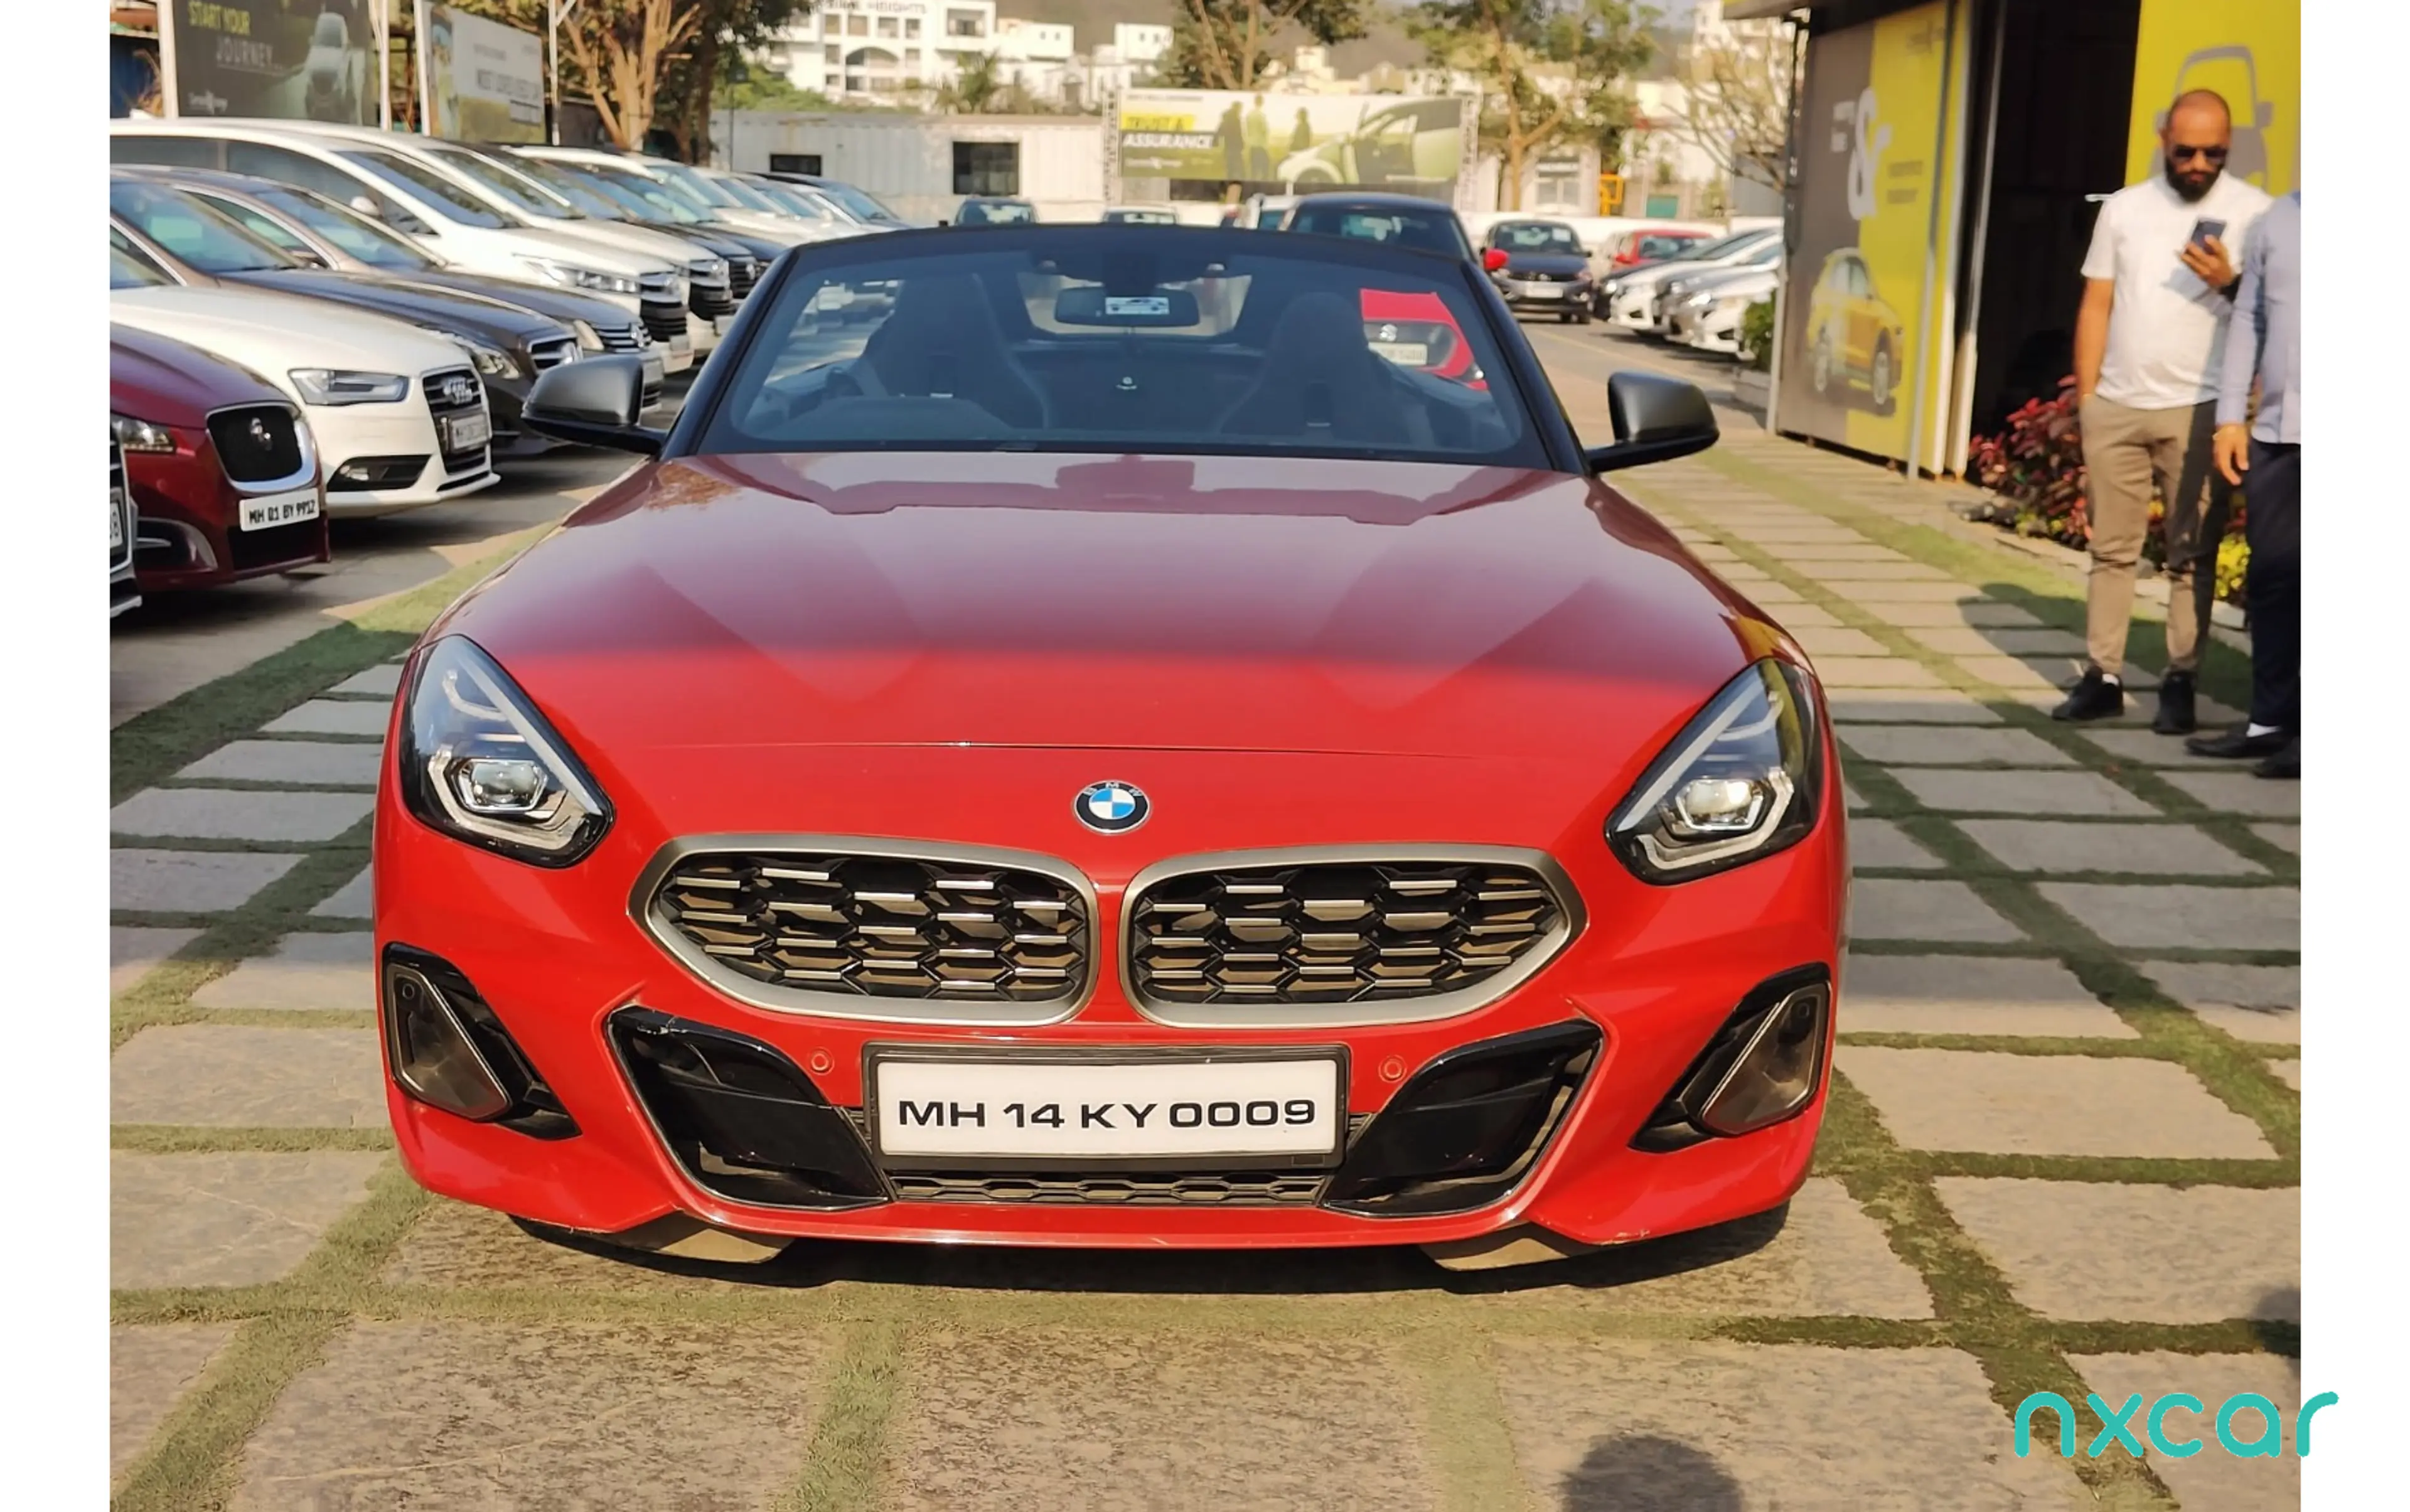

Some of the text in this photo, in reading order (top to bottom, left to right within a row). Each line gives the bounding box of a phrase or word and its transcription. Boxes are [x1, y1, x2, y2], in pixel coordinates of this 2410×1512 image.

[188, 1, 250, 35] START YOUR
[1122, 132, 1214, 149] ASSURANCE
[249, 508, 265, 524] MH
[900, 1102, 985, 1127] MH
[1004, 1104, 1064, 1127] 14
[1170, 1100, 1314, 1127] 0009
